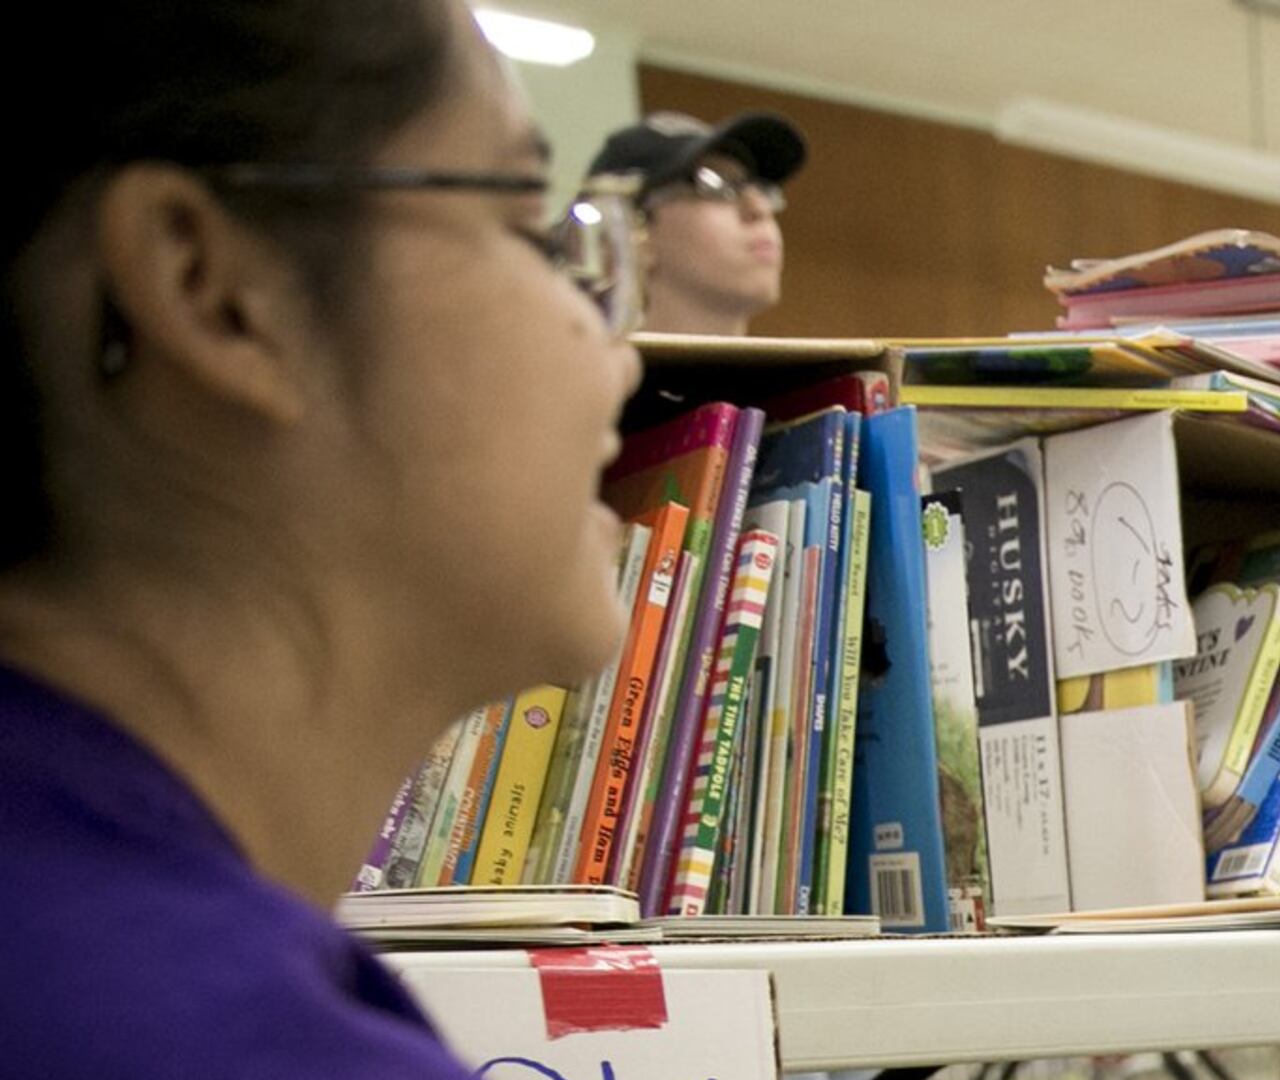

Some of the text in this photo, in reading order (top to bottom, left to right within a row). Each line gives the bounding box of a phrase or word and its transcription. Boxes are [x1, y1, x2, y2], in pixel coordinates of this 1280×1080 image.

[996, 491, 1029, 679] HUSKY
[622, 677, 644, 727] Green
[610, 736, 632, 780] Eggs
[709, 676, 743, 799] THE TINY TADPOLE
[604, 786, 619, 817] and
[492, 782, 525, 885] baby animals
[594, 825, 613, 863] Ham
